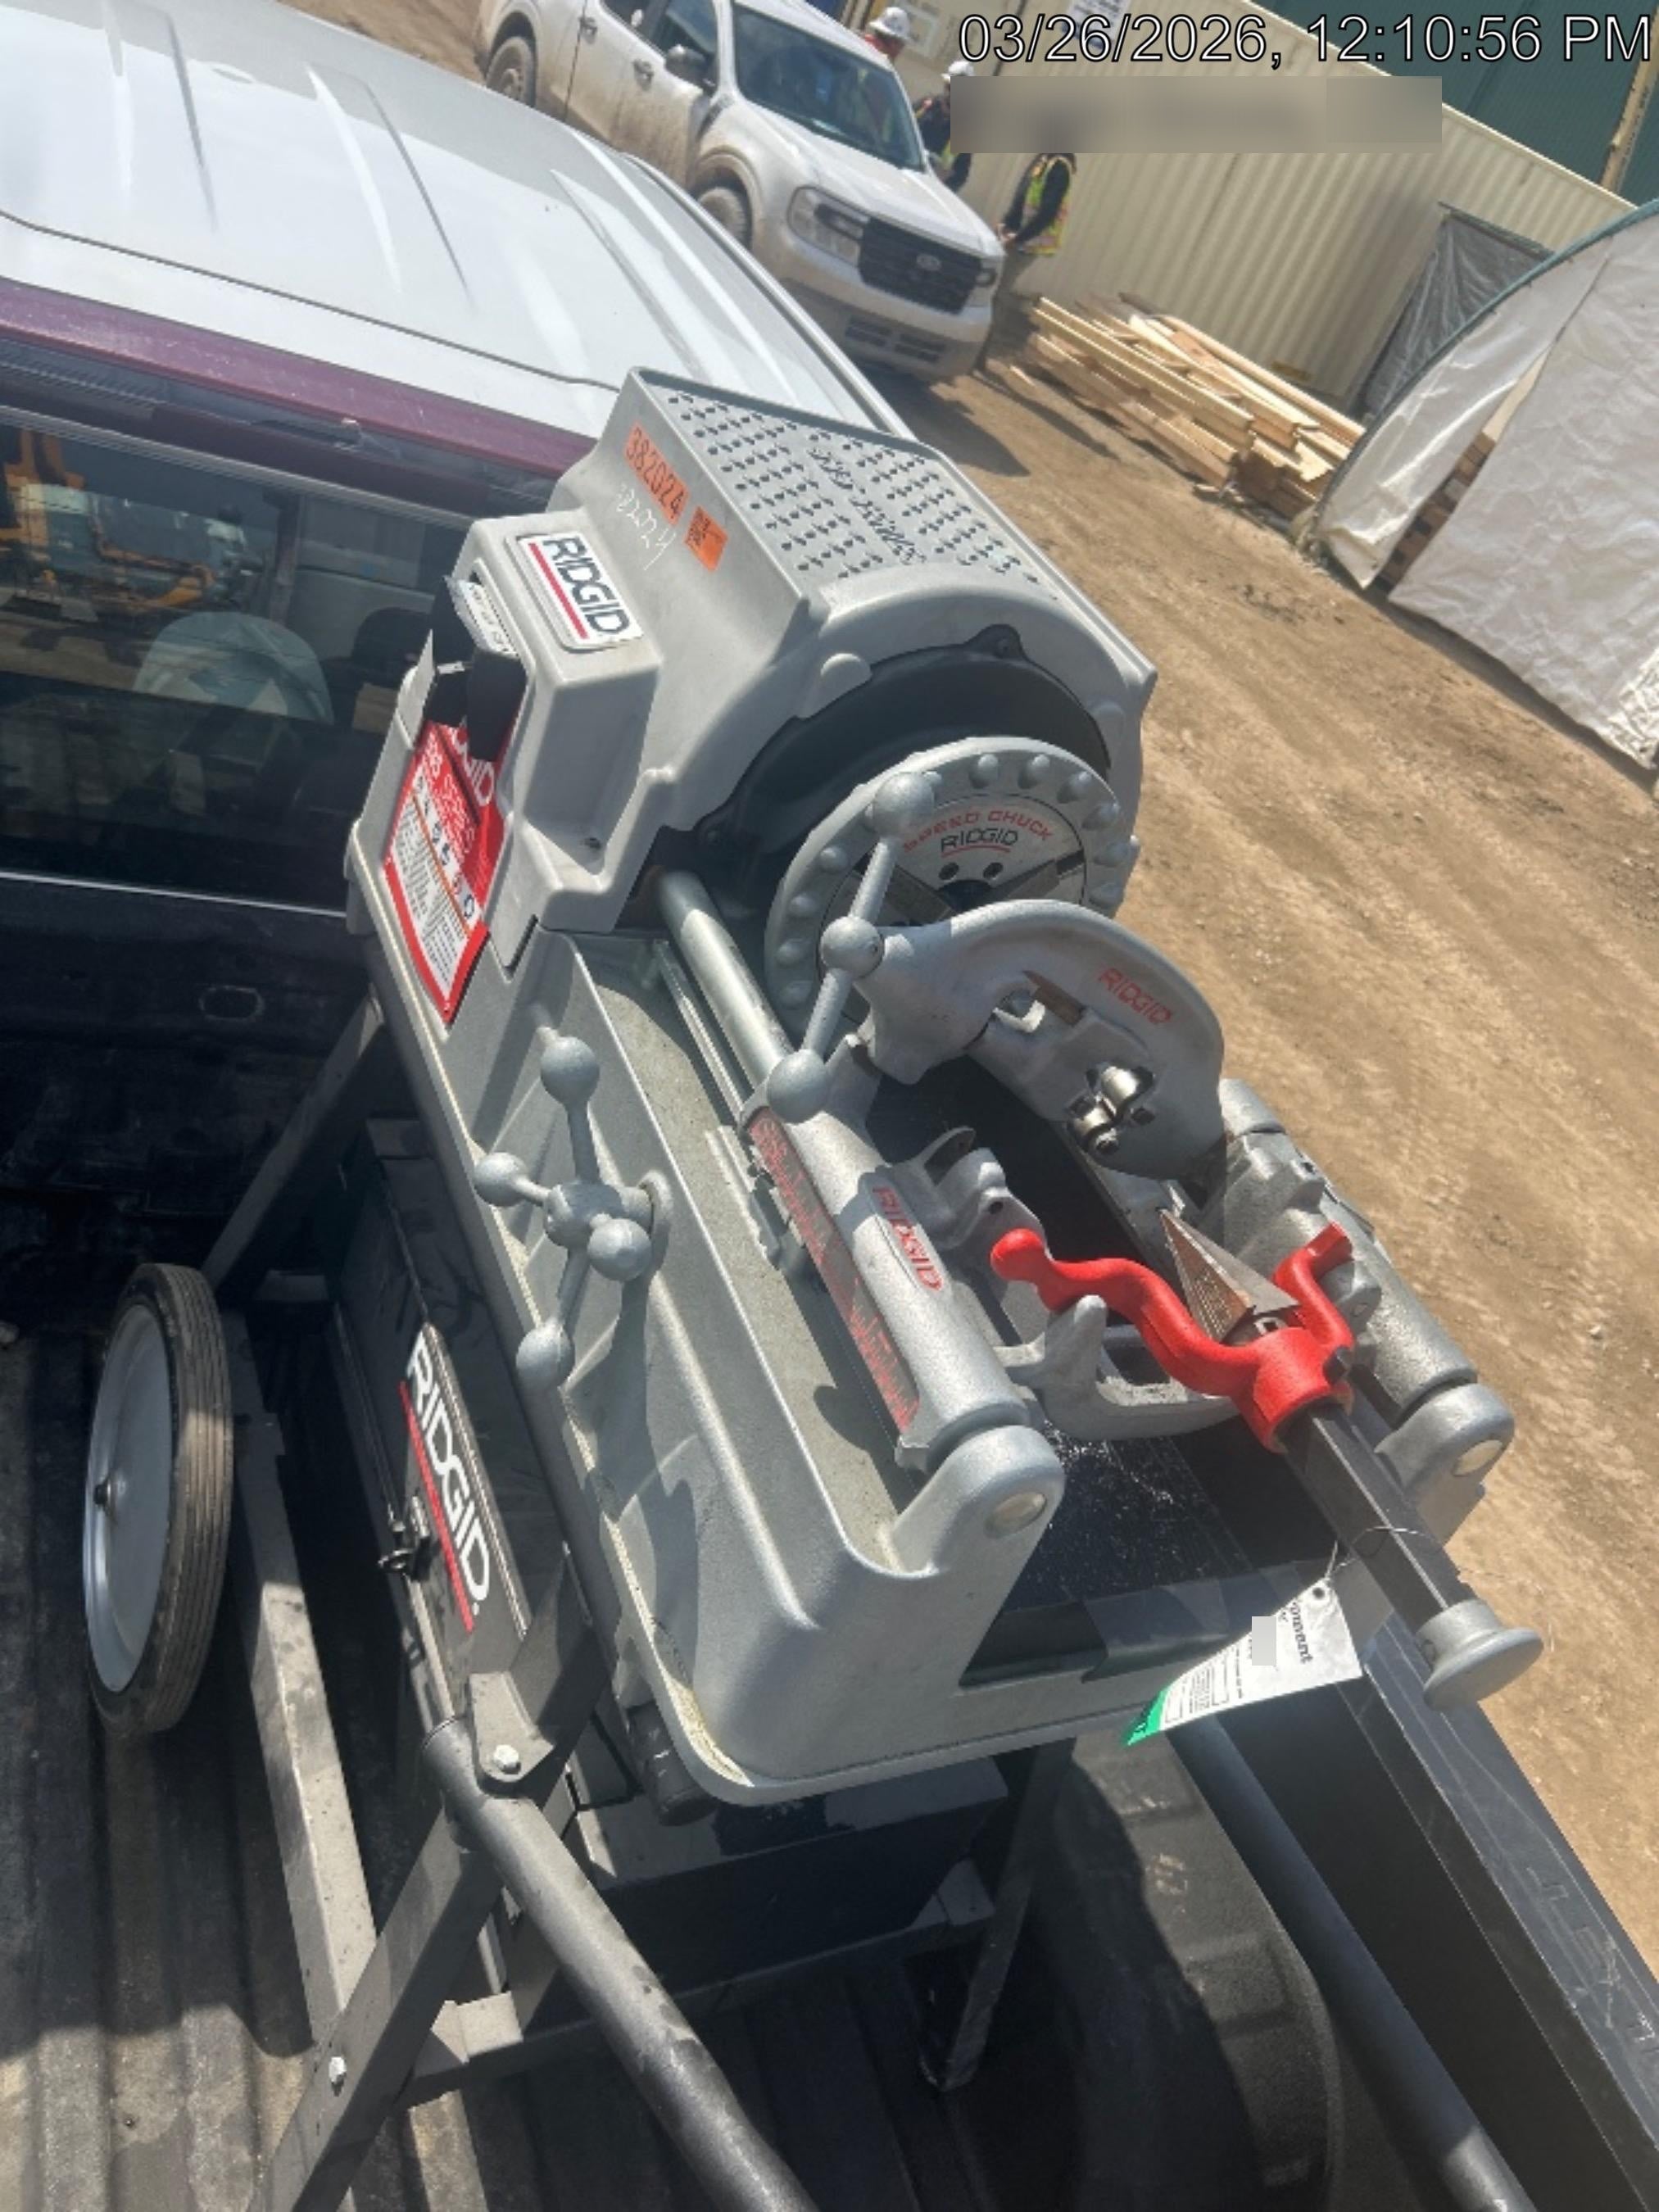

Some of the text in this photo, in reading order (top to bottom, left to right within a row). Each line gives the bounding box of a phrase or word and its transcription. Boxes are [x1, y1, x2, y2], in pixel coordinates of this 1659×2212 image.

[626, 427, 685, 519] 382024
[542, 537, 630, 634] RIDGID
[941, 827, 1018, 853] RIDGID
[988, 809, 1054, 841] CHUCK
[1098, 967, 1172, 1025] RIDGID
[872, 1185, 945, 1292] RIDGID
[406, 1330, 490, 1602] RIDGID
